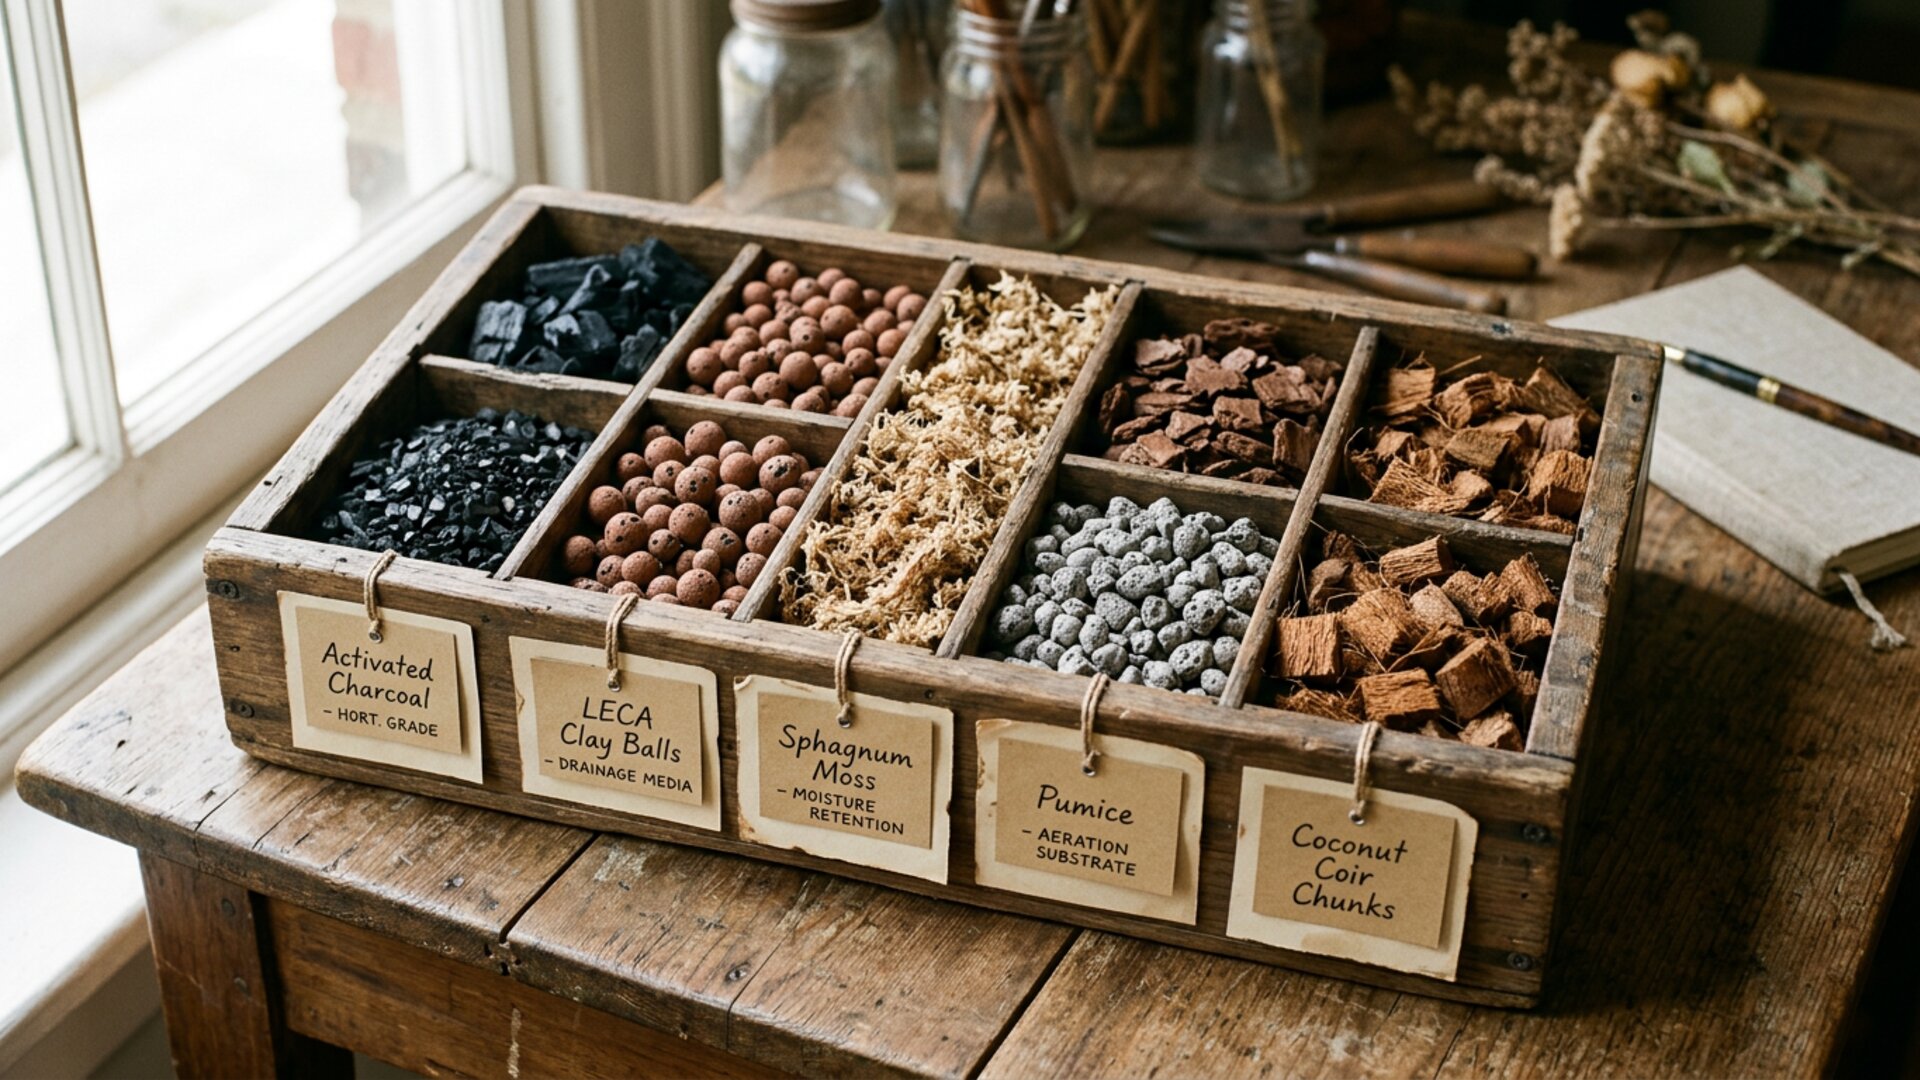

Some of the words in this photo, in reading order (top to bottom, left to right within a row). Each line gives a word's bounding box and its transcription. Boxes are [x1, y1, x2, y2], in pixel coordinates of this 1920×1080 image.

[321, 641, 434, 682] Activated
[327, 670, 430, 710] Charcoal
[338, 707, 382, 727] HORT.
[386, 716, 438, 738] GRADE
[582, 696, 653, 730] LECA
[560, 721, 613, 761] Clay
[622, 731, 682, 763] Balls
[778, 724, 913, 769] Sphagnum
[558, 756, 637, 783] DRAINAGE
[642, 772, 693, 794] MEDIA
[812, 759, 876, 791] Moss
[792, 787, 876, 814] MOISTURE
[1036, 783, 1134, 826] Pumice
[809, 806, 904, 836] RETENTION
[1036, 827, 1129, 856] AERATION
[1291, 823, 1408, 864] Coconut
[1036, 845, 1137, 877] SUBSTRATE
[1314, 856, 1375, 886] Coir
[1292, 881, 1396, 920] Chunks
